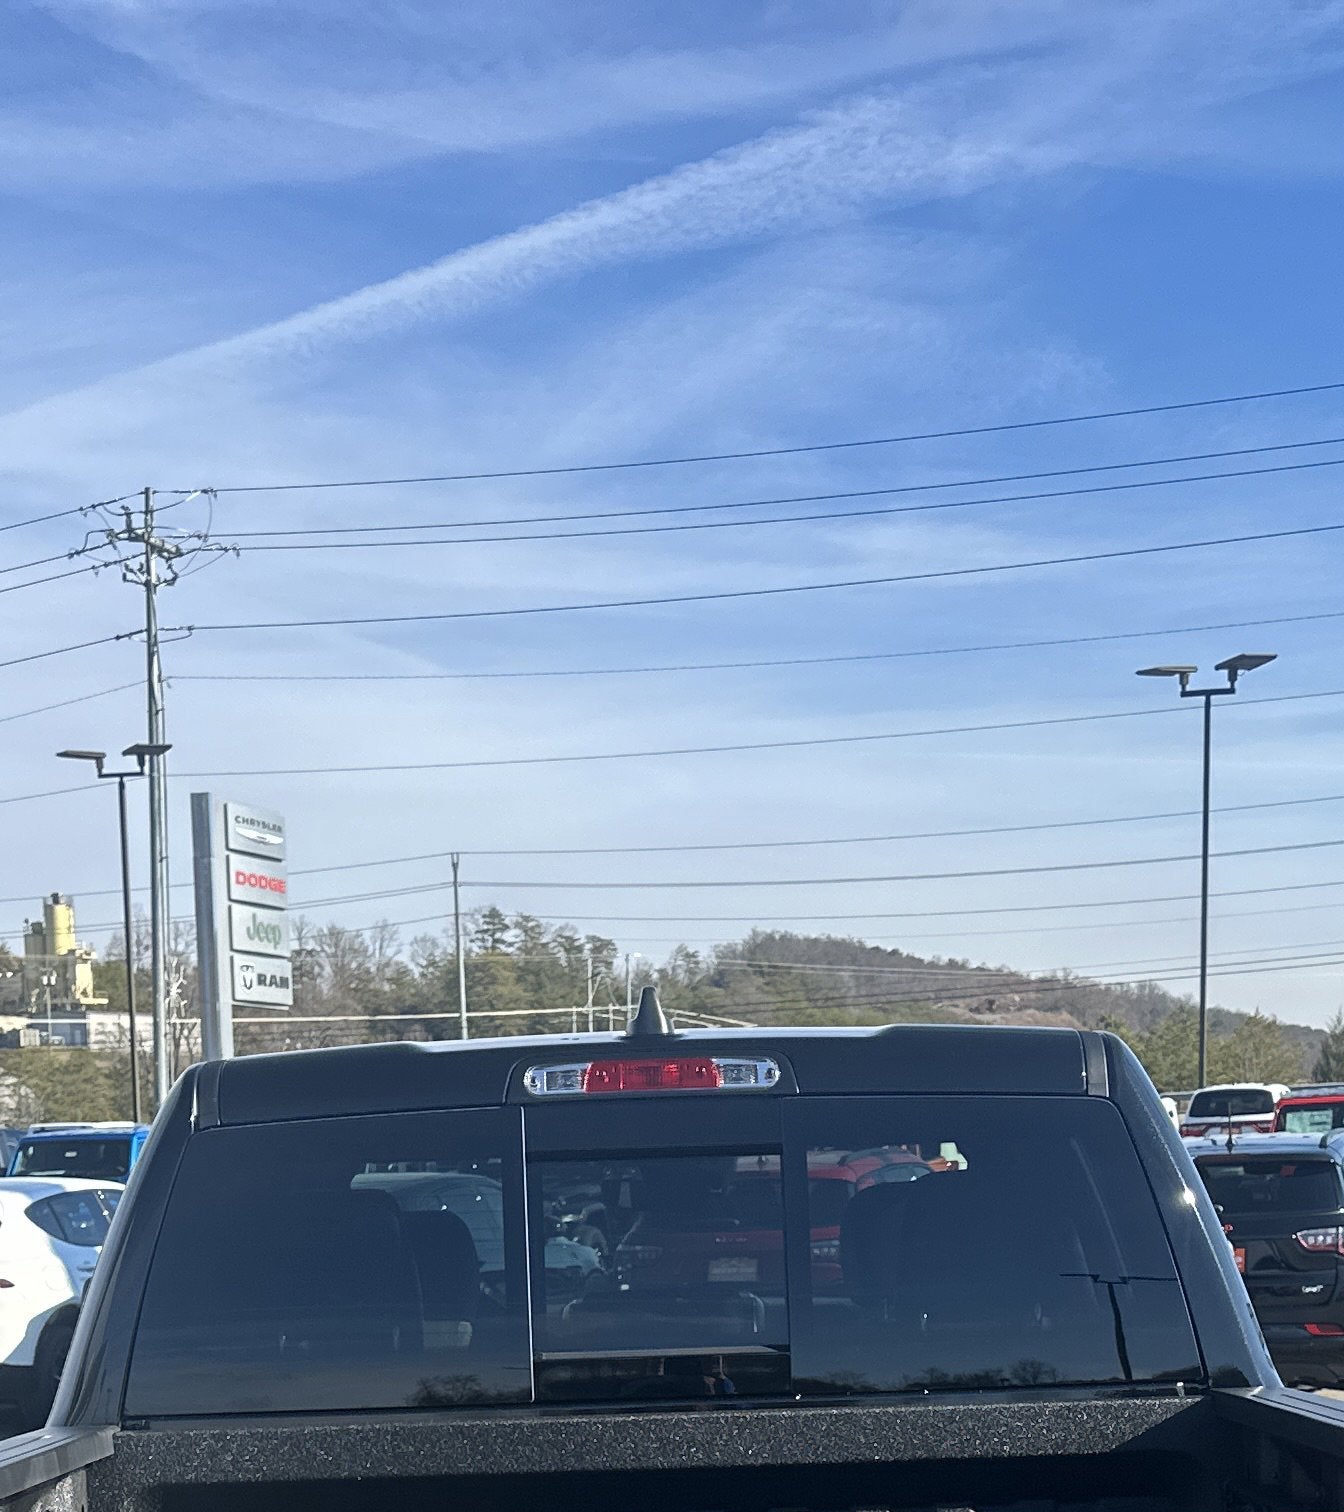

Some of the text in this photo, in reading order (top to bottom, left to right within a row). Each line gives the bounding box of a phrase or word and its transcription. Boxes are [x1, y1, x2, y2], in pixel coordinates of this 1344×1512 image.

[234, 815, 283, 833] CHRYSLER
[235, 871, 286, 893] DODGE
[246, 912, 282, 950] Jeep
[257, 972, 290, 990] RAM
